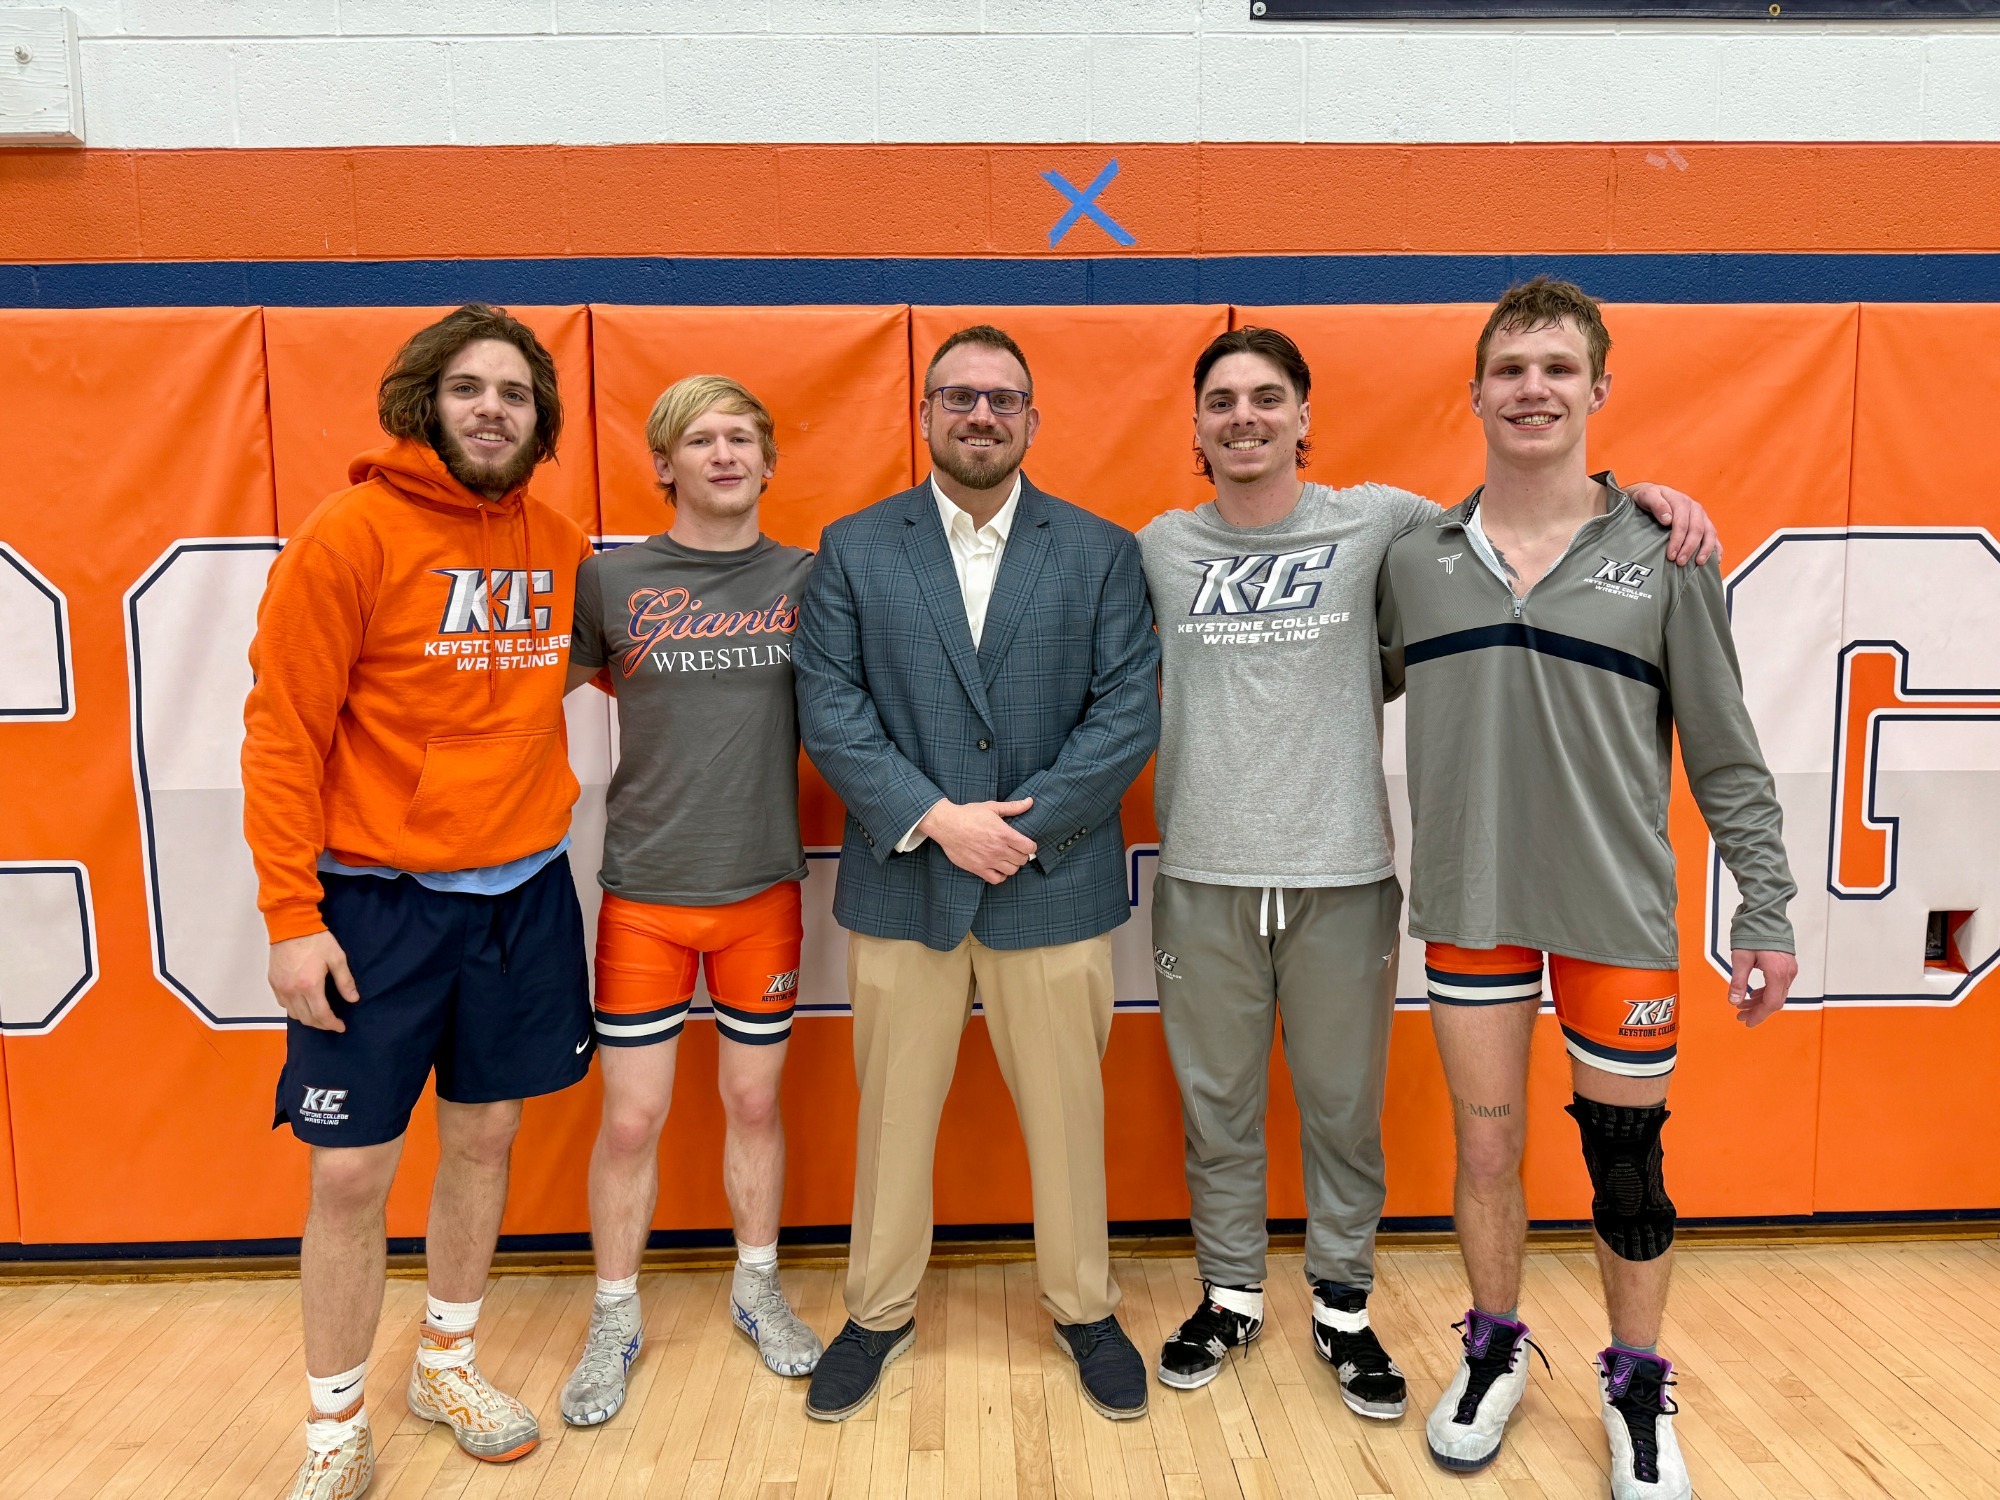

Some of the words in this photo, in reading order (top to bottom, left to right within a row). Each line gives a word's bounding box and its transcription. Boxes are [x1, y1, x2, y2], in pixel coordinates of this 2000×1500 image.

[1189, 544, 1338, 616] KC
[1592, 556, 1654, 589] KC
[425, 568, 553, 635] KC
[622, 586, 800, 679] Giants
[1178, 621, 1264, 634] KEYSTONE
[1270, 612, 1350, 630] COLLEGE
[1202, 627, 1321, 645] WRESTLING
[516, 634, 572, 652] COLLEG
[651, 643, 791, 673] WRESTLIN
[1622, 993, 1678, 1027] KC
[302, 1085, 349, 1113] KC
